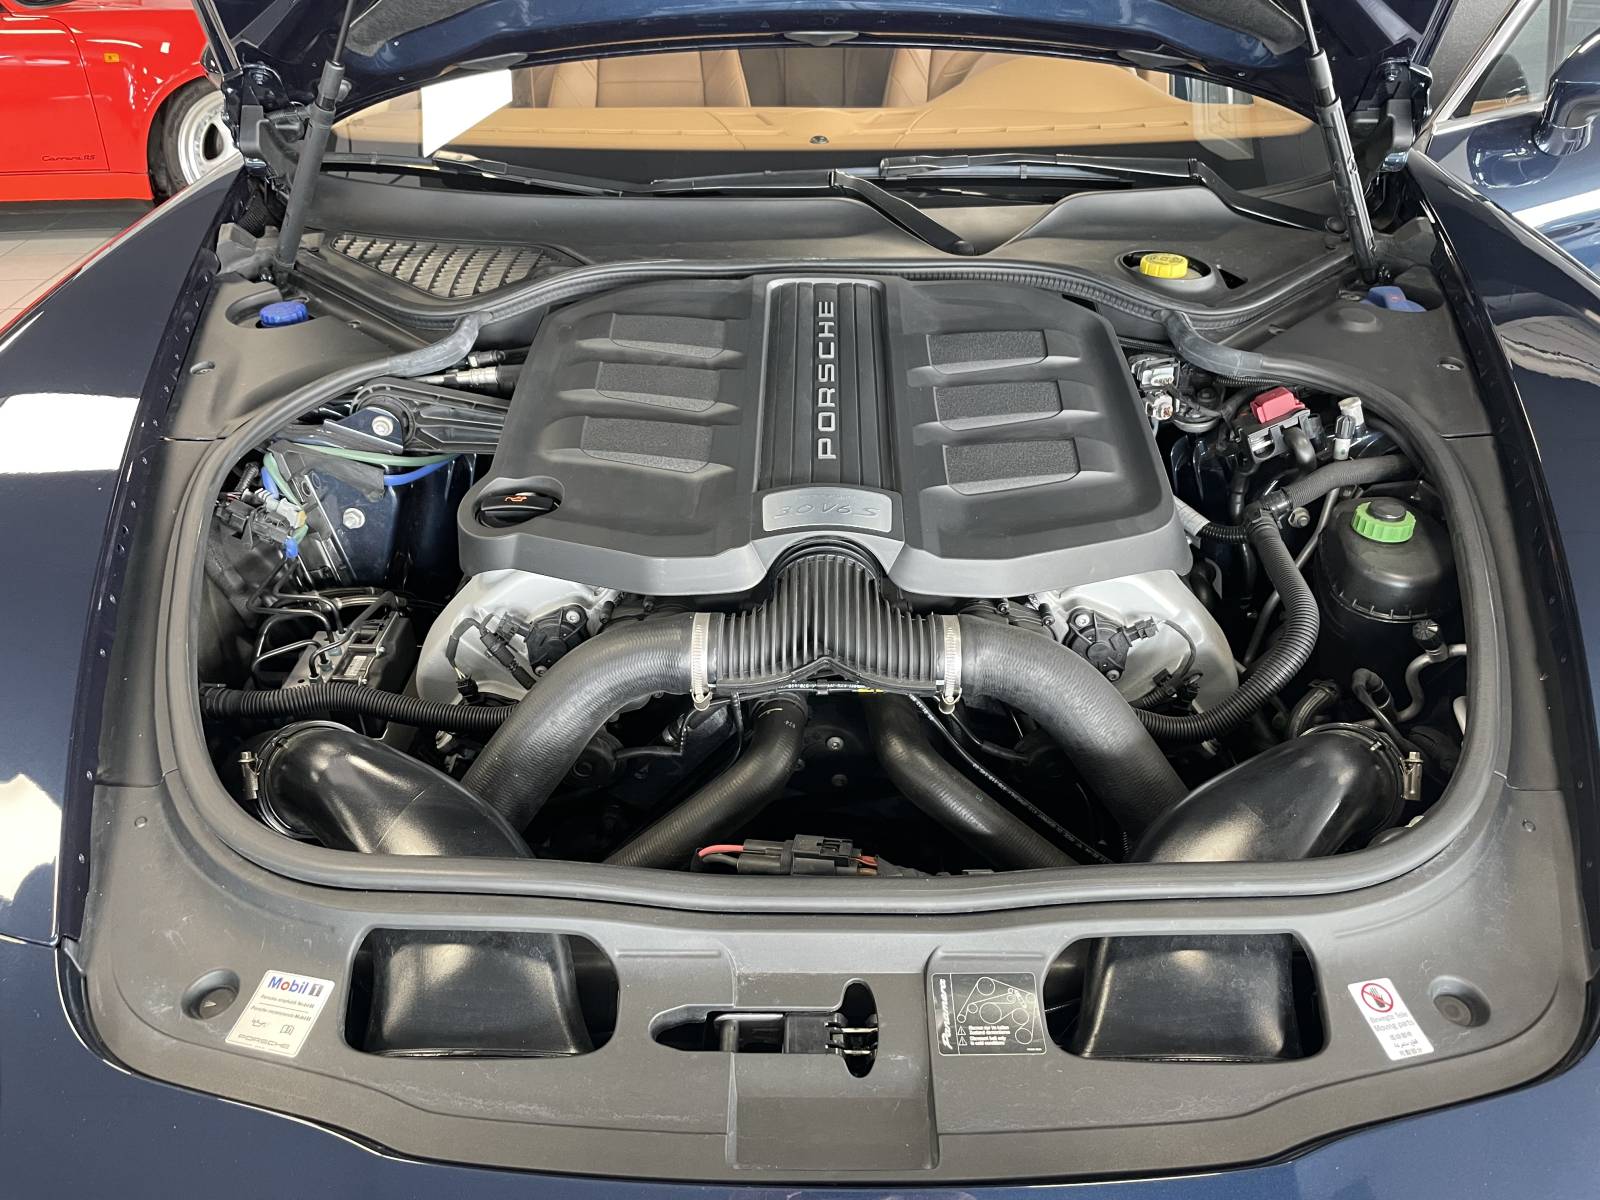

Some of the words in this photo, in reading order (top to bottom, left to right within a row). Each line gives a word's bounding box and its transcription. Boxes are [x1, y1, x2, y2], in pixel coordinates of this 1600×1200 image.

[817, 301, 837, 460] PORSCHE
[267, 975, 309, 995] Mobil
[939, 978, 954, 1050] Panamera
